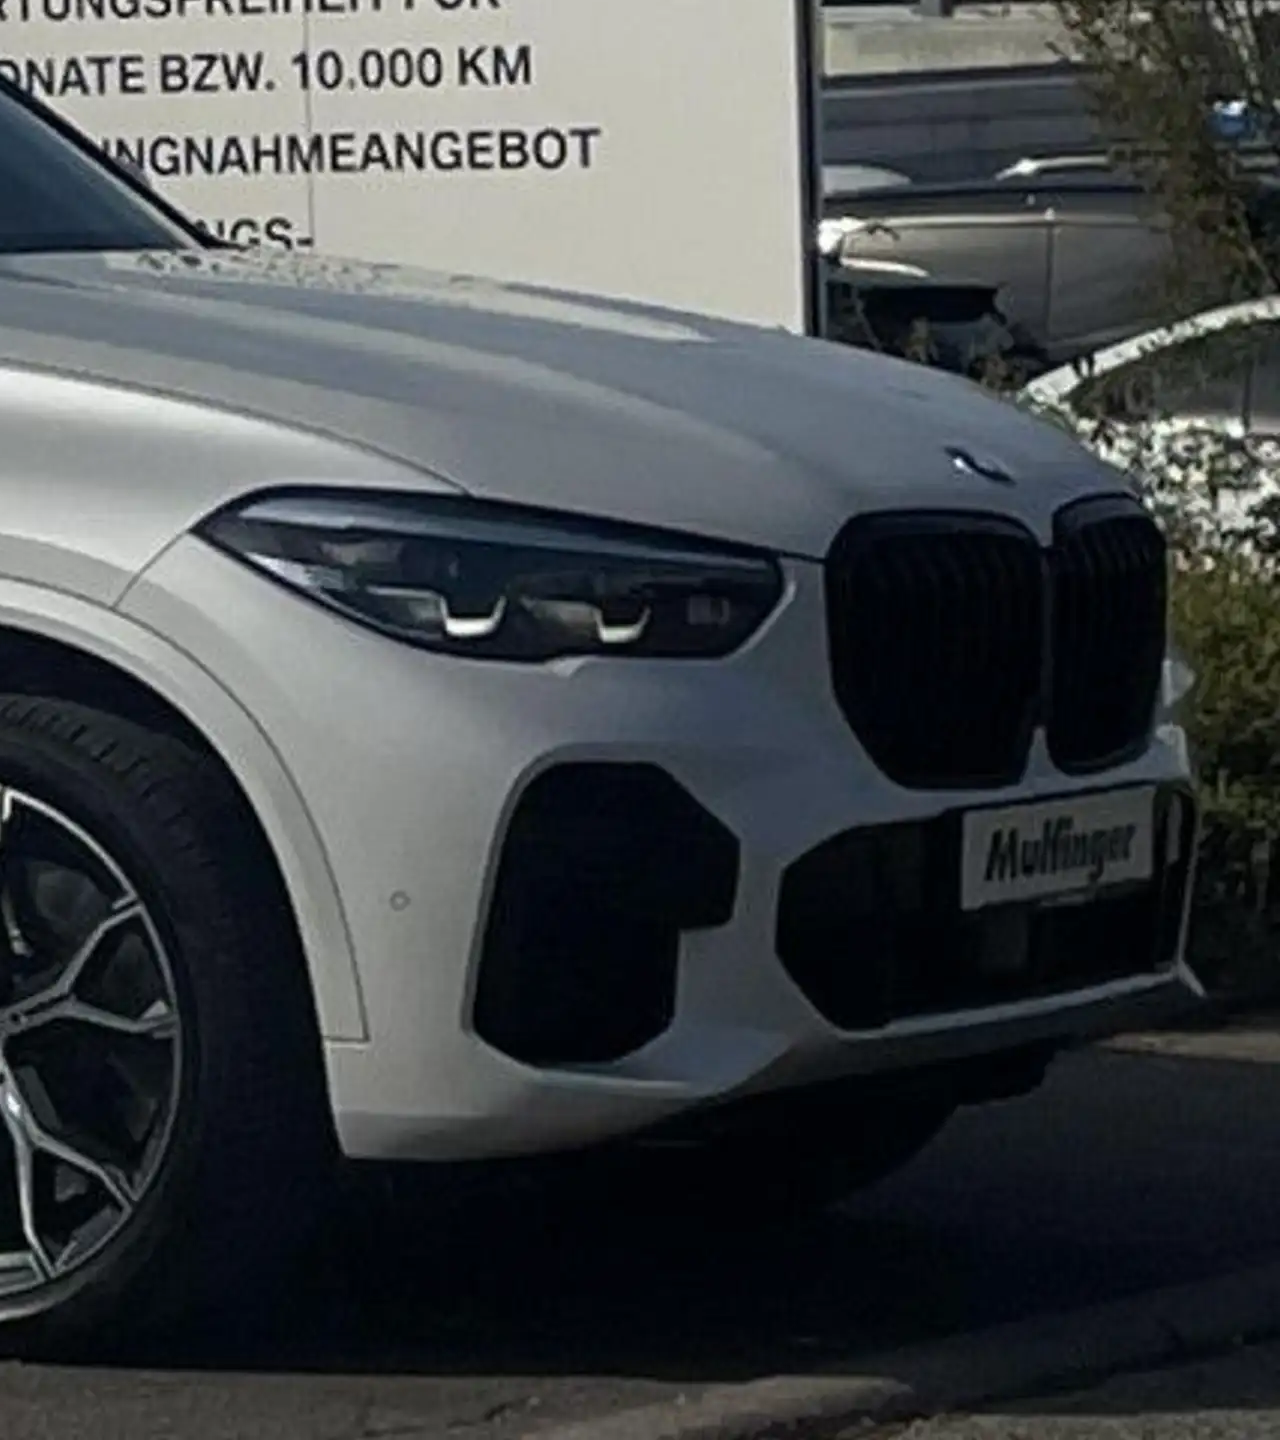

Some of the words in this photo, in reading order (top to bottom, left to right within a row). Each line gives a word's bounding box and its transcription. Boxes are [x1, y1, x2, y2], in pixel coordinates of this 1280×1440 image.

[160, 51, 276, 94] BZW.
[292, 47, 443, 91] 10.000
[458, 45, 532, 87] KM
